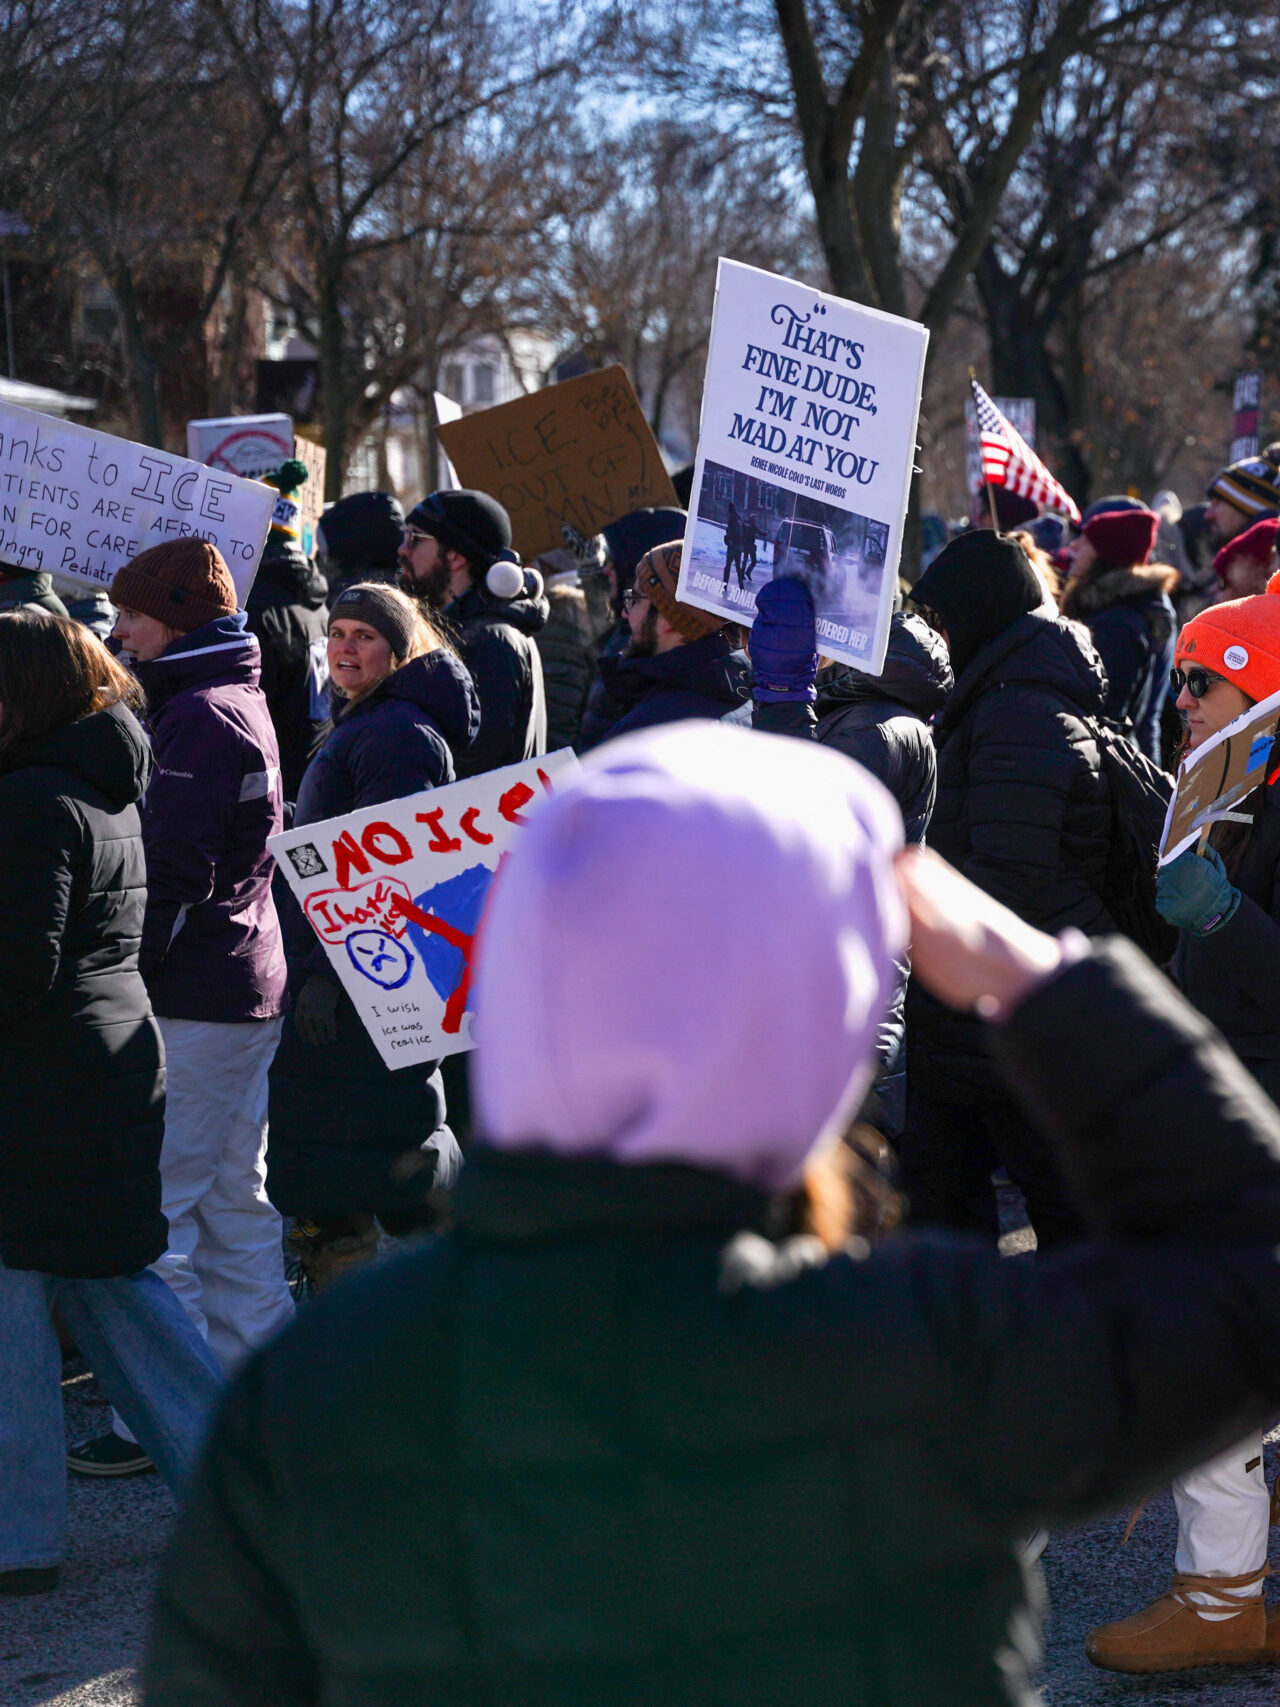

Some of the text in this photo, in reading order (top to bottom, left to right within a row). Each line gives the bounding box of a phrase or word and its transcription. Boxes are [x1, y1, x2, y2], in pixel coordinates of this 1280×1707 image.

[741, 343, 878, 416] FINE DUDE,
[755, 385, 860, 442] I'M NOT
[728, 412, 880, 485] MAD AT YOU
[88, 441, 118, 487] to
[131, 456, 232, 523] ICE
[499, 463, 570, 513] OUT
[750, 455, 768, 471] RENEE
[767, 461, 789, 479] NICOLE
[809, 477, 826, 491] LAST
[824, 482, 847, 499] WORDS
[0, 473, 255, 560] TIENTS ARE AFRAID TO
[31, 512, 72, 540] FOR
[86, 530, 139, 558] CARE
[61, 547, 114, 584] Pediatr
[692, 571, 758, 612] BEFORE JONAT
[814, 617, 868, 651] RDERED HER
[331, 821, 414, 889] NO
[312, 900, 343, 933] I
[370, 1002, 421, 1018] I wish
[381, 1022, 423, 1036] ice was
[390, 1035, 432, 1050] real ice
